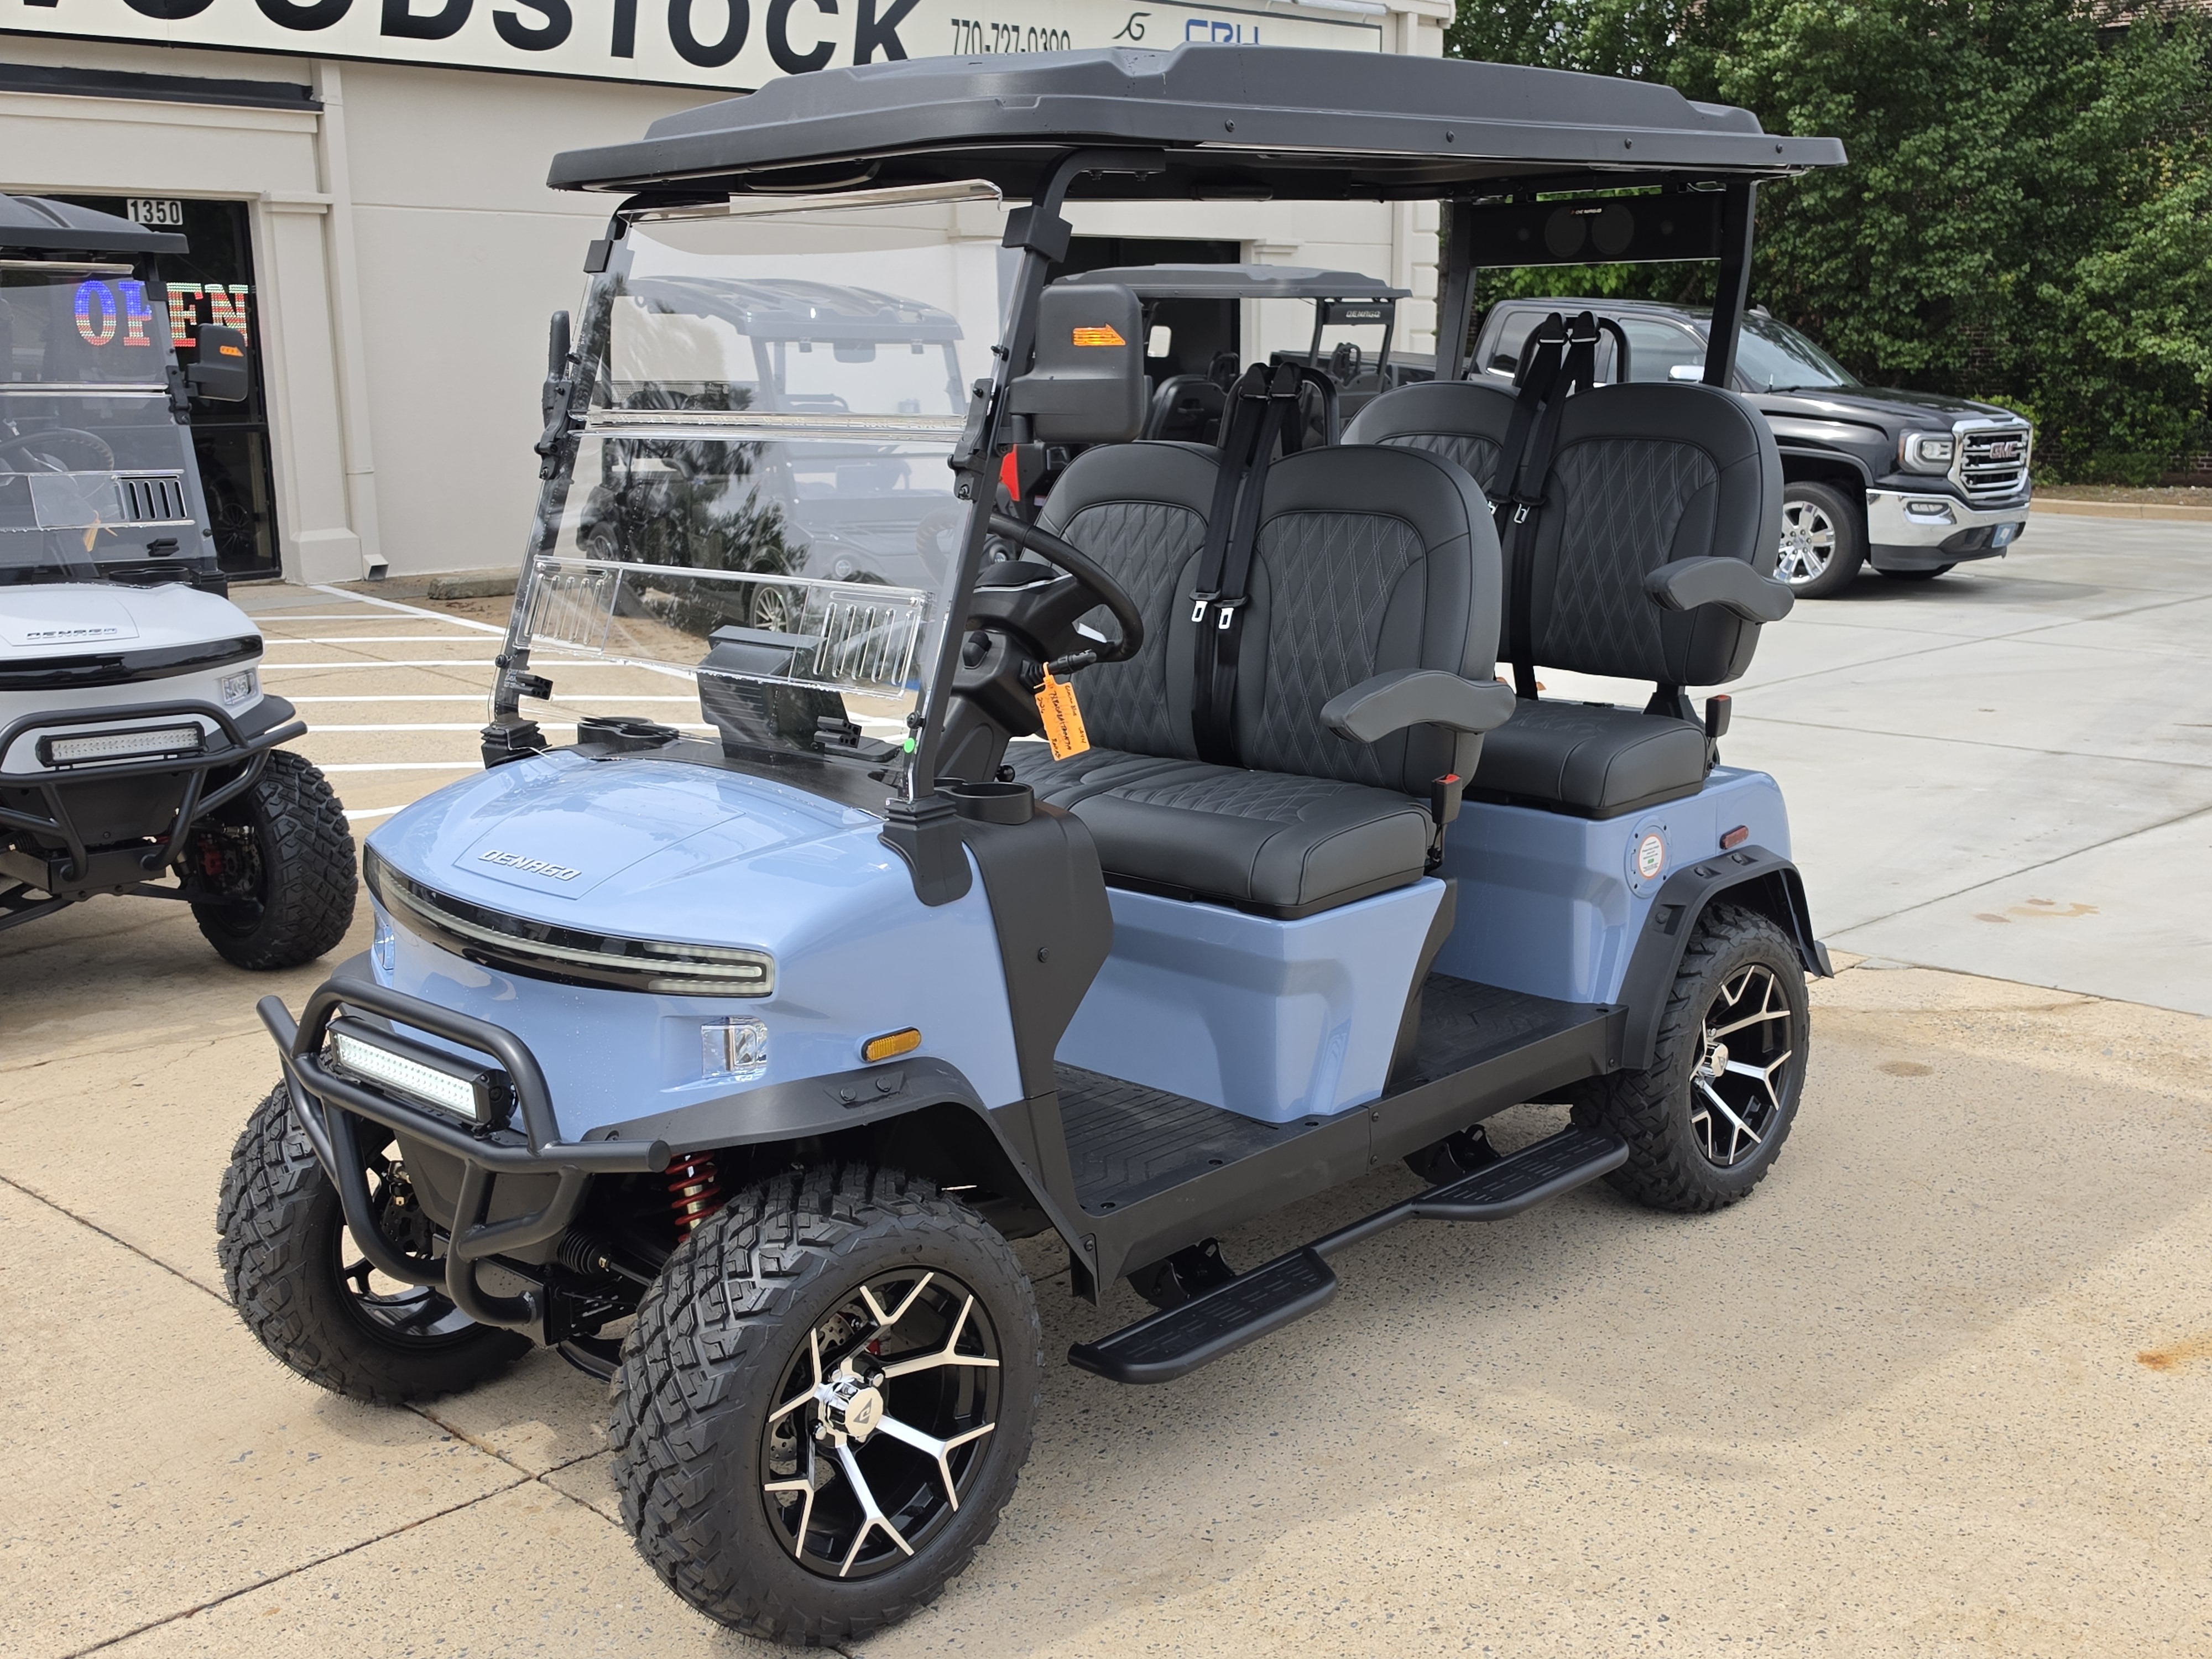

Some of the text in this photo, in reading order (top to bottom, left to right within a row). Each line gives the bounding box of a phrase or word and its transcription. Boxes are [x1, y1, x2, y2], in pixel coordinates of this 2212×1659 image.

[131, 200, 180, 223] 1350
[74, 280, 248, 347] OPEN
[1990, 441, 2022, 458] GMC
[27, 628, 117, 640] DENAGO
[478, 849, 582, 881] DENAGO
